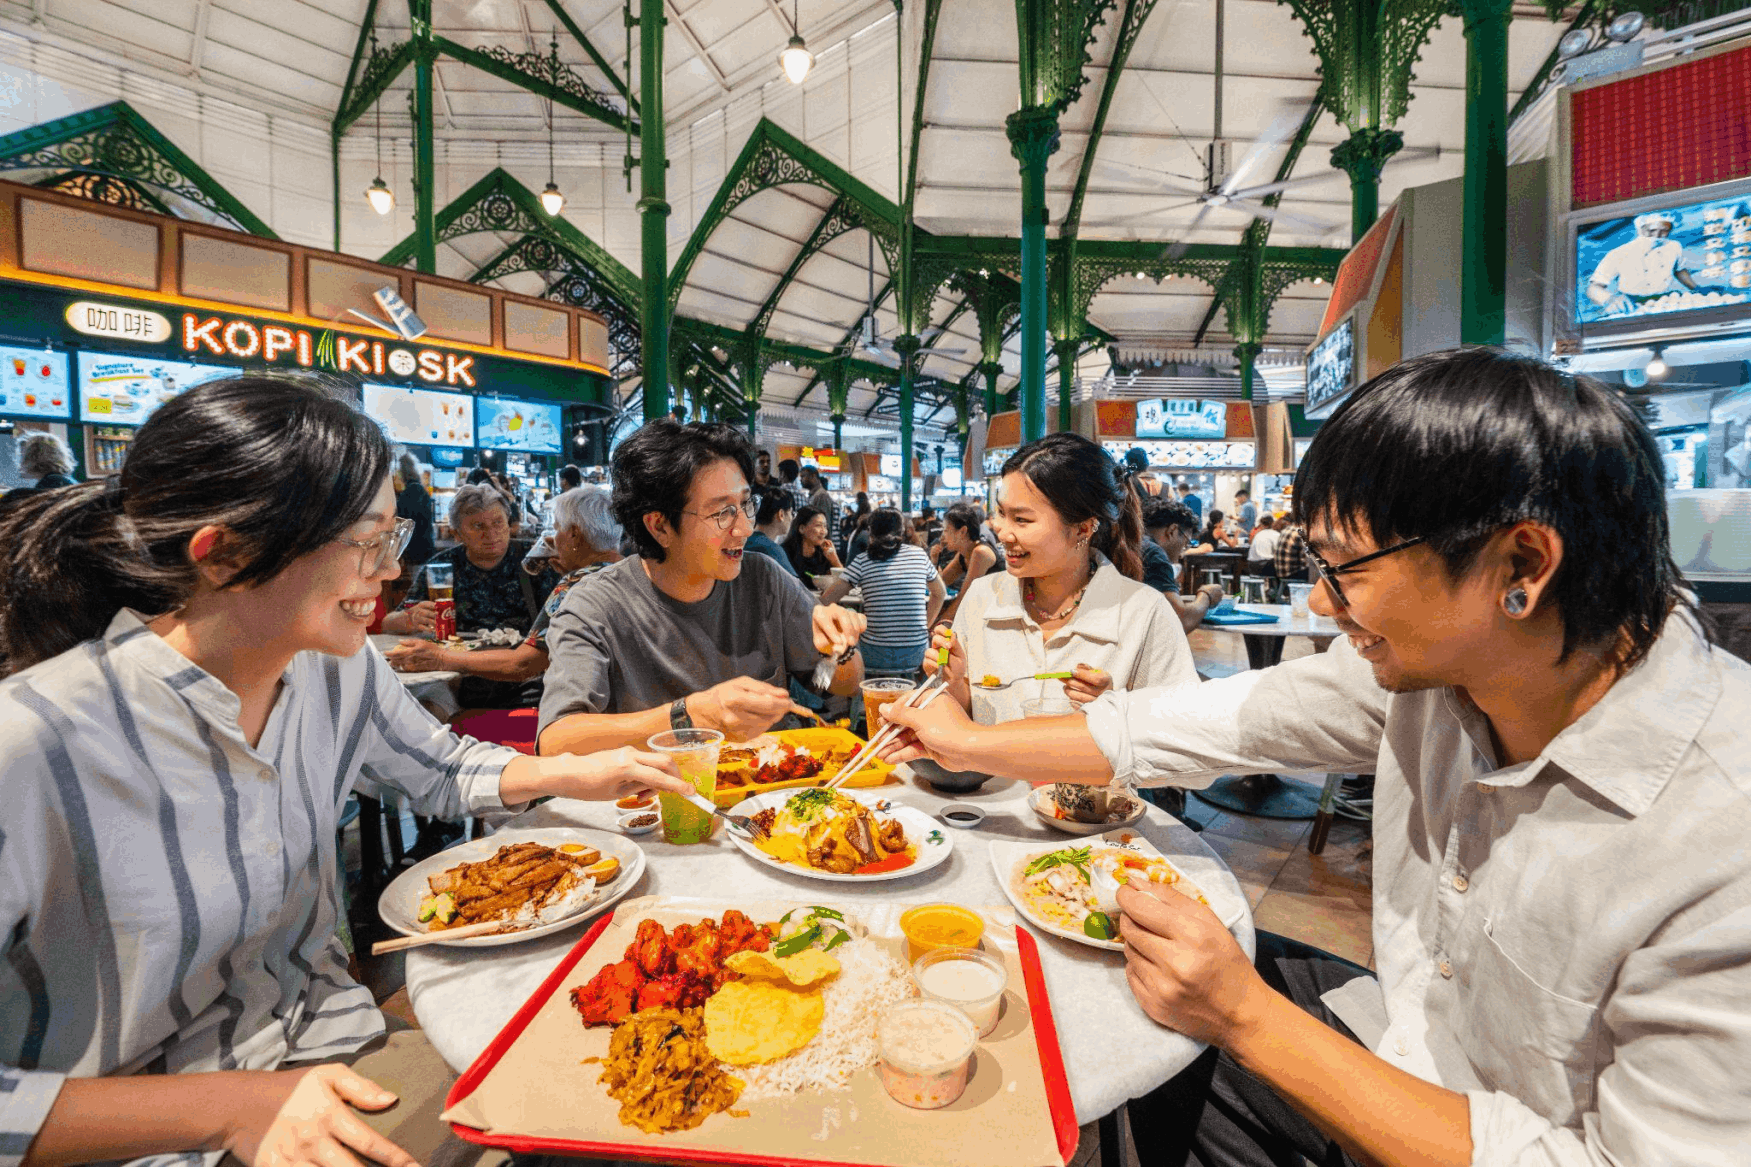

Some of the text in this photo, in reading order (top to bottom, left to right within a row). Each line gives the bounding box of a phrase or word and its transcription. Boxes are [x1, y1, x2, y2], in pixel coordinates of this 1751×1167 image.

[87, 307, 153, 336] 咖啡
[182, 313, 476, 387] KOPI KIOSK
[92, 368, 130, 377] Breakfast
[95, 363, 133, 371] Signature
